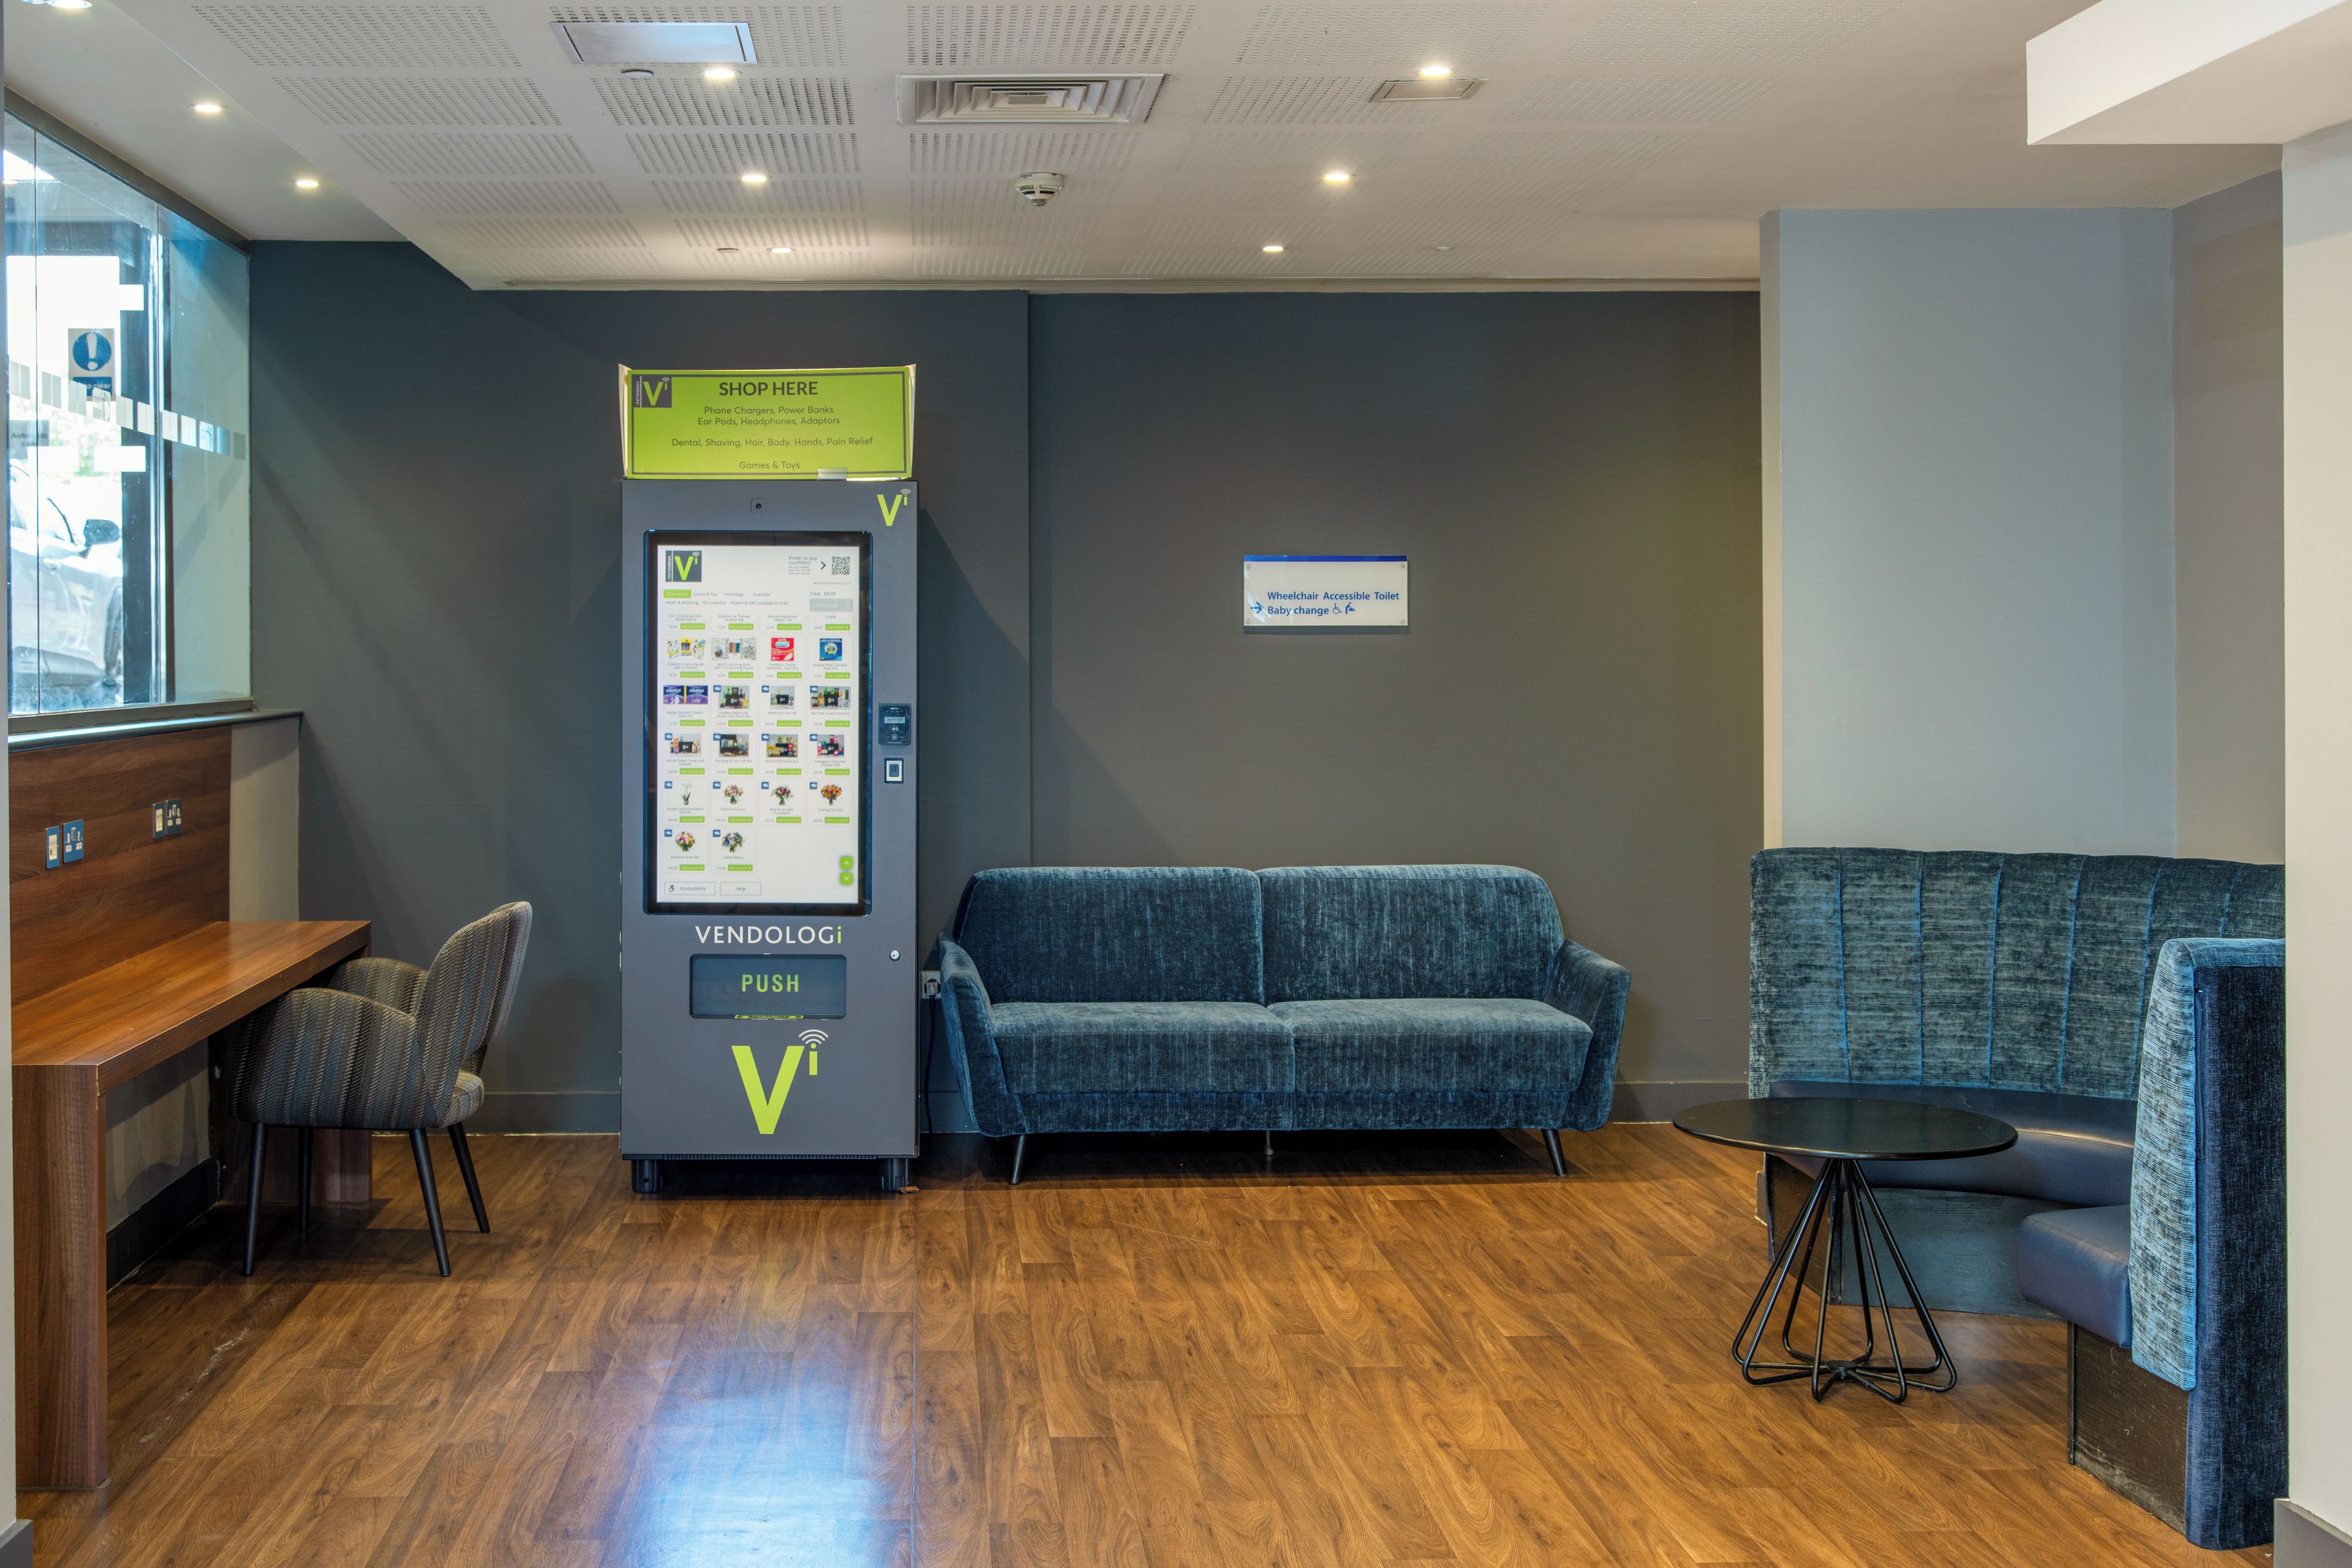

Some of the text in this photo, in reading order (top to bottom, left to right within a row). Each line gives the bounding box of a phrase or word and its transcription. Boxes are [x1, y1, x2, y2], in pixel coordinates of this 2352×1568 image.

[719, 381, 818, 396] SHOP HERE
[704, 406, 834, 415] Phone Chargers, Power Banks
[698, 417, 840, 426] Ear Pods, Headphones, Adaptors
[672, 437, 873, 448] Dental, Shaving, Hair, Body, Hands, Pain Relief
[739, 461, 800, 471] Games & Toys
[877, 494, 907, 527] Vi
[1268, 592, 1400, 600] Wheelchair Accessible Toilet
[1268, 606, 1329, 616] Baby change
[695, 925, 842, 944] VENDOLOGi
[742, 974, 799, 992] PUSH
[731, 1042, 818, 1134] Vi
